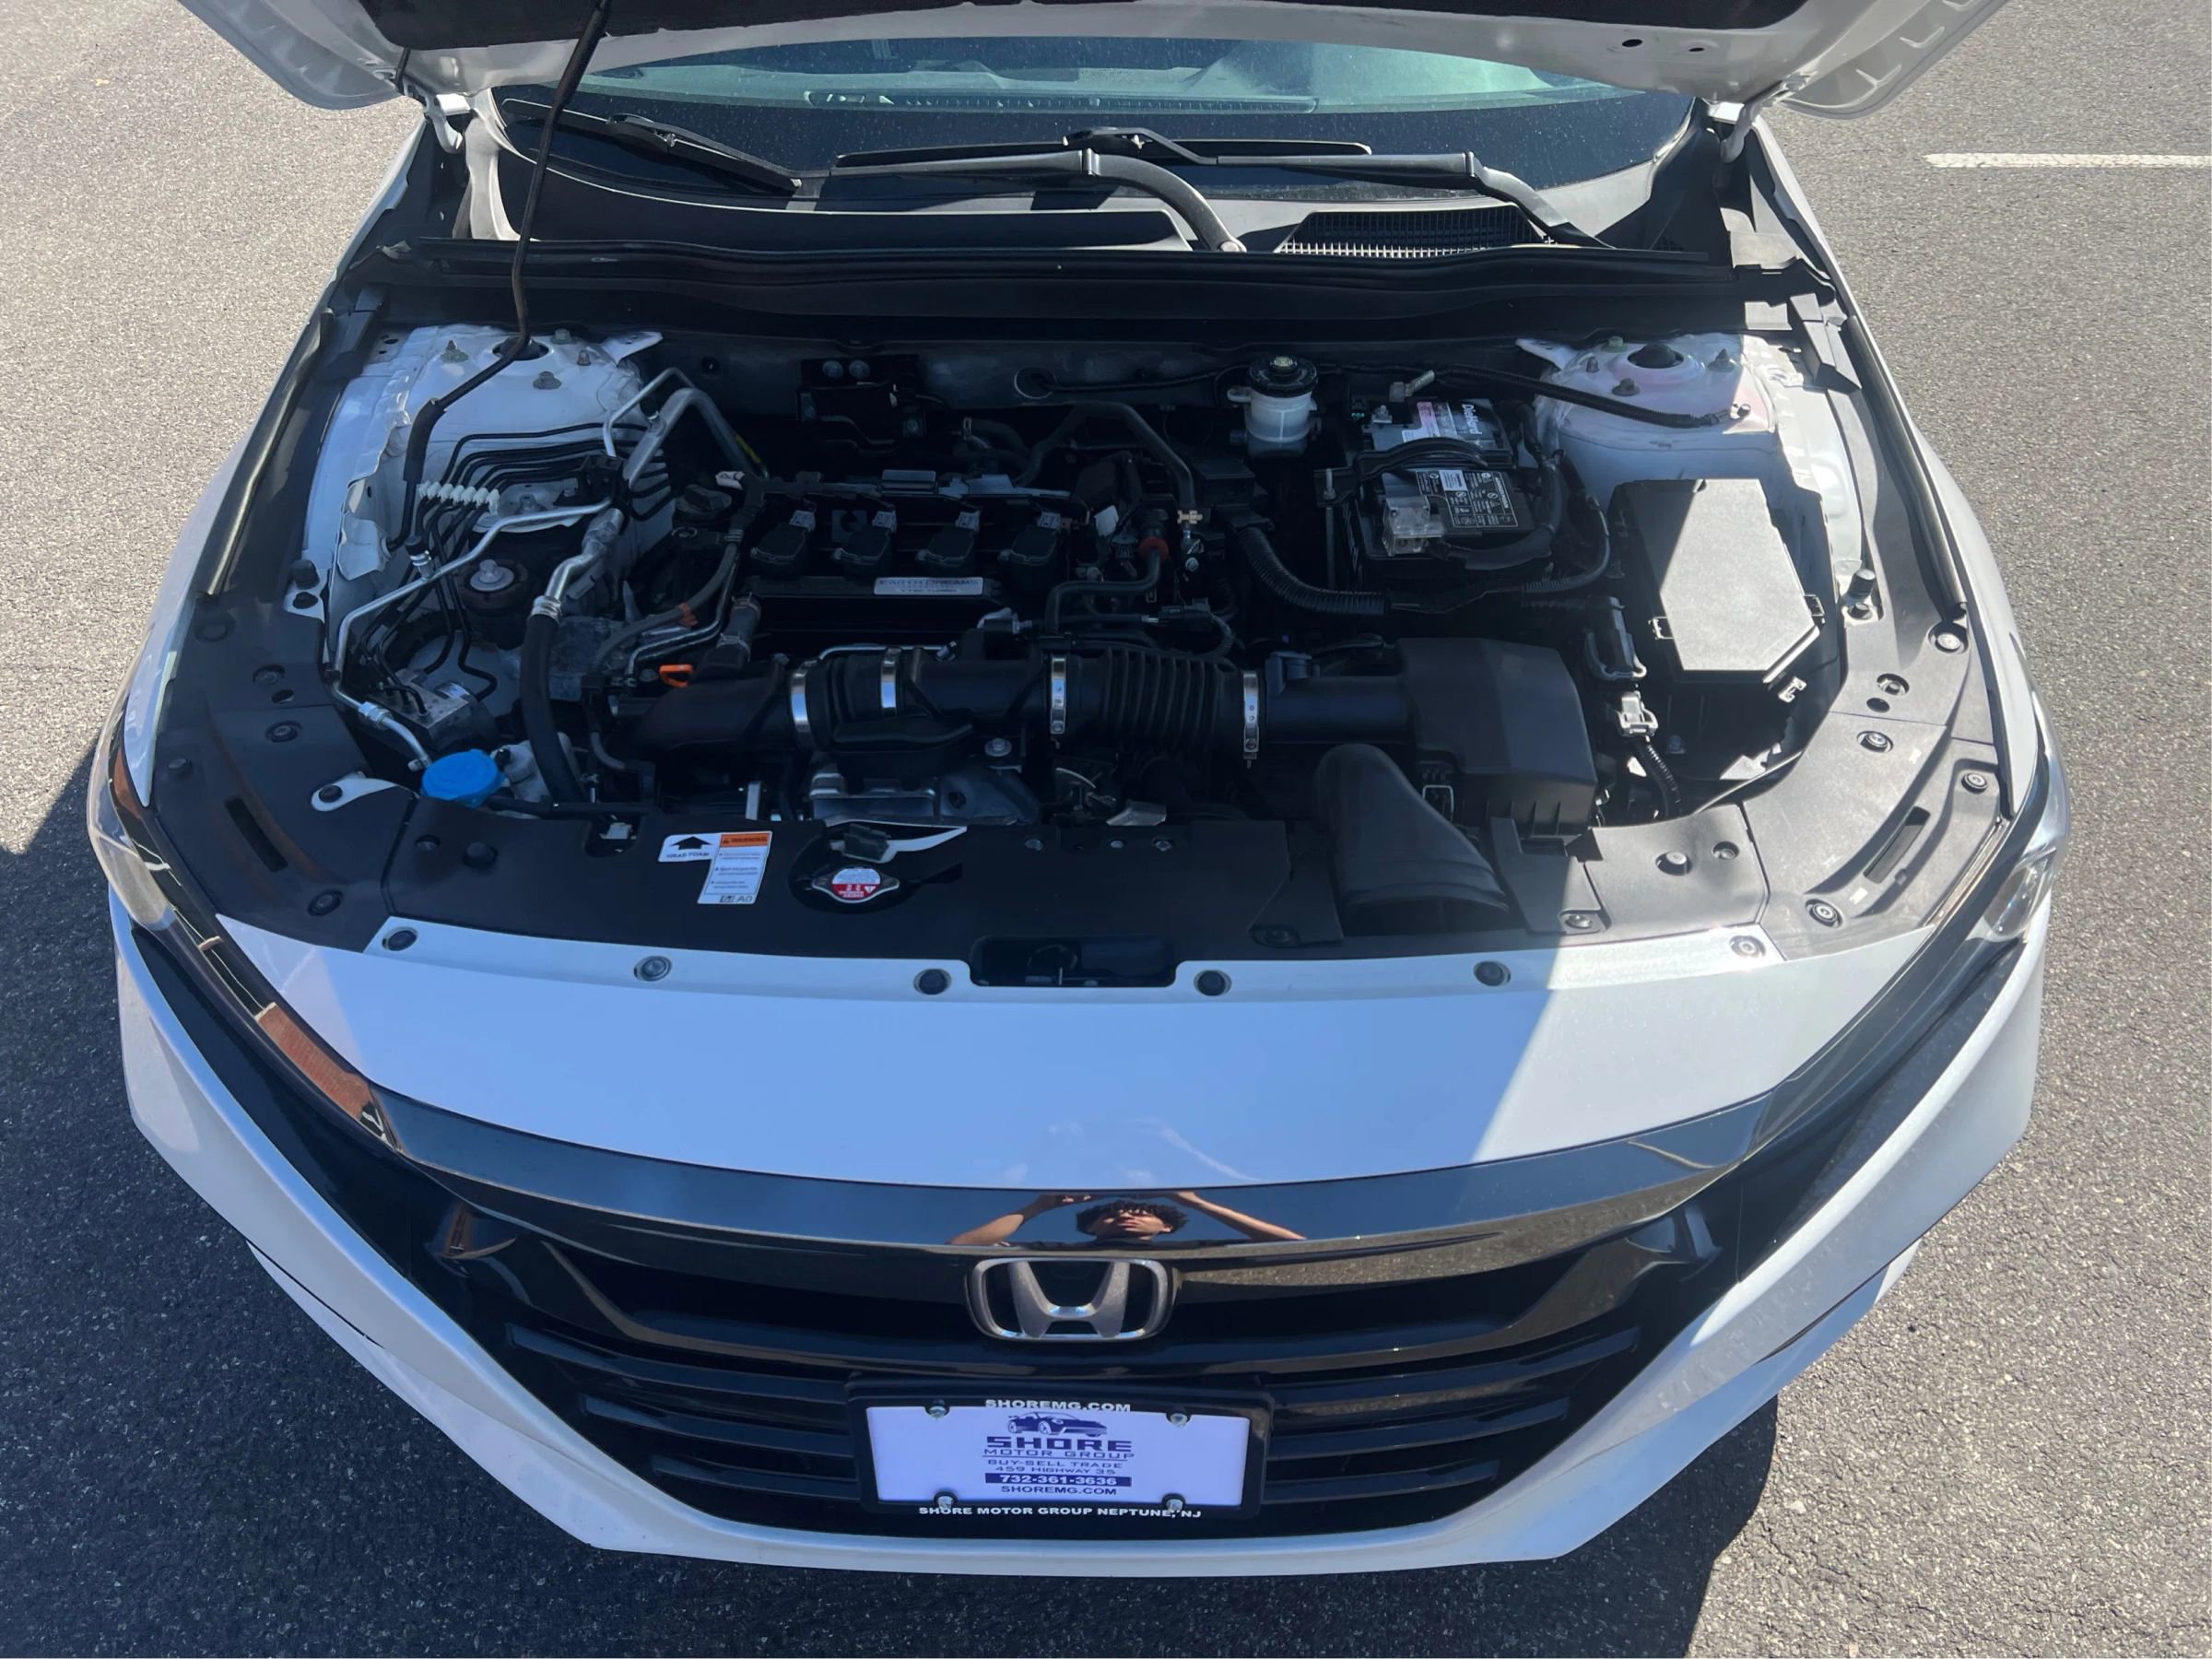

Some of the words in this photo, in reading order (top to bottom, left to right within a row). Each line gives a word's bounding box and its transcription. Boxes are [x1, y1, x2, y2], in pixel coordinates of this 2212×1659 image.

[1461, 404, 1483, 435] DieHard
[985, 1399, 1131, 1412] SHOREMG.COM
[986, 1436, 1132, 1452] SHORE
[984, 1448, 1053, 1457] MOTOR
[1065, 1451, 1135, 1459] GROUP
[987, 1459, 1066, 1467] BUY-SELL
[1000, 1475, 1117, 1486] 732-361-3636
[1001, 1486, 1117, 1495] SHOREMG.COM
[918, 1506, 972, 1514] SHORE
[977, 1507, 1033, 1515] MOTOR
[1037, 1507, 1093, 1515] GROUP
[1181, 1510, 1202, 1518] NJ
